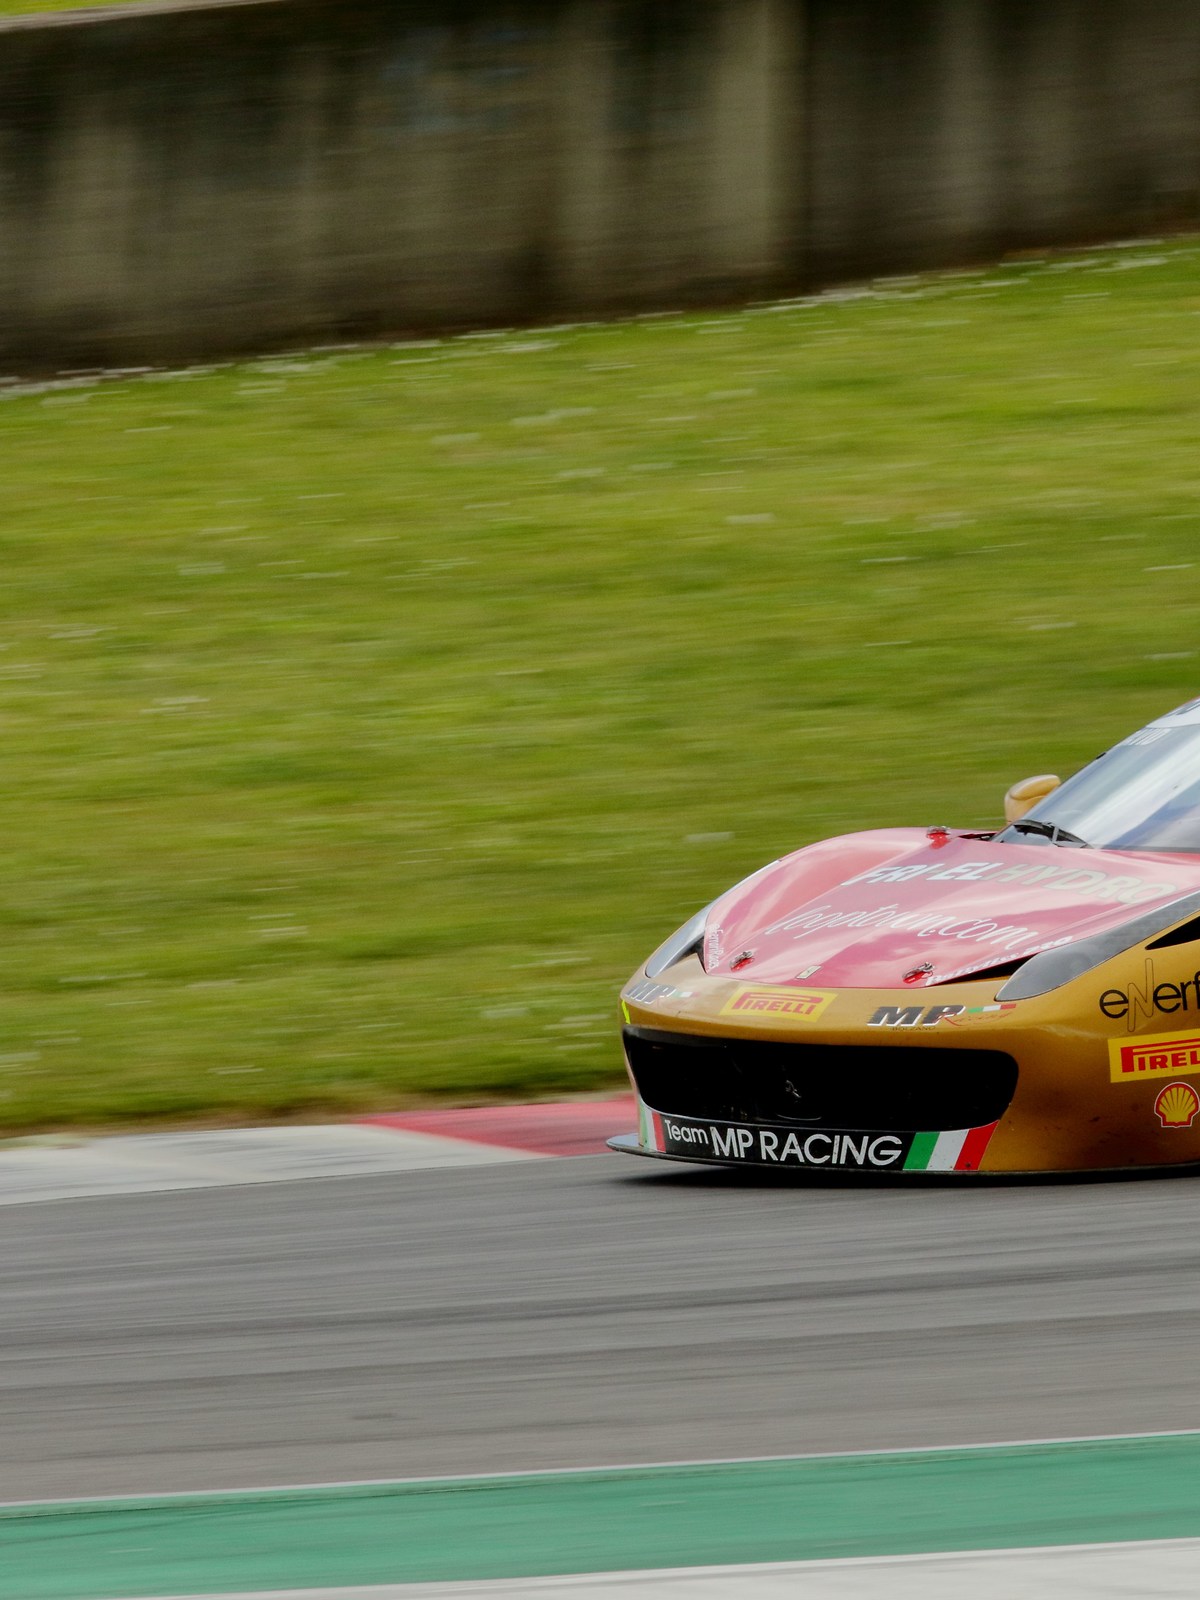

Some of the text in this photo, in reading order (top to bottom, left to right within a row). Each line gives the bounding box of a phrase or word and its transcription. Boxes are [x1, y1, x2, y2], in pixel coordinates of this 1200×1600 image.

[731, 991, 824, 1015] PIRELLI
[867, 1005, 966, 1027] MP
[664, 1119, 902, 1166] Team MP RACING
